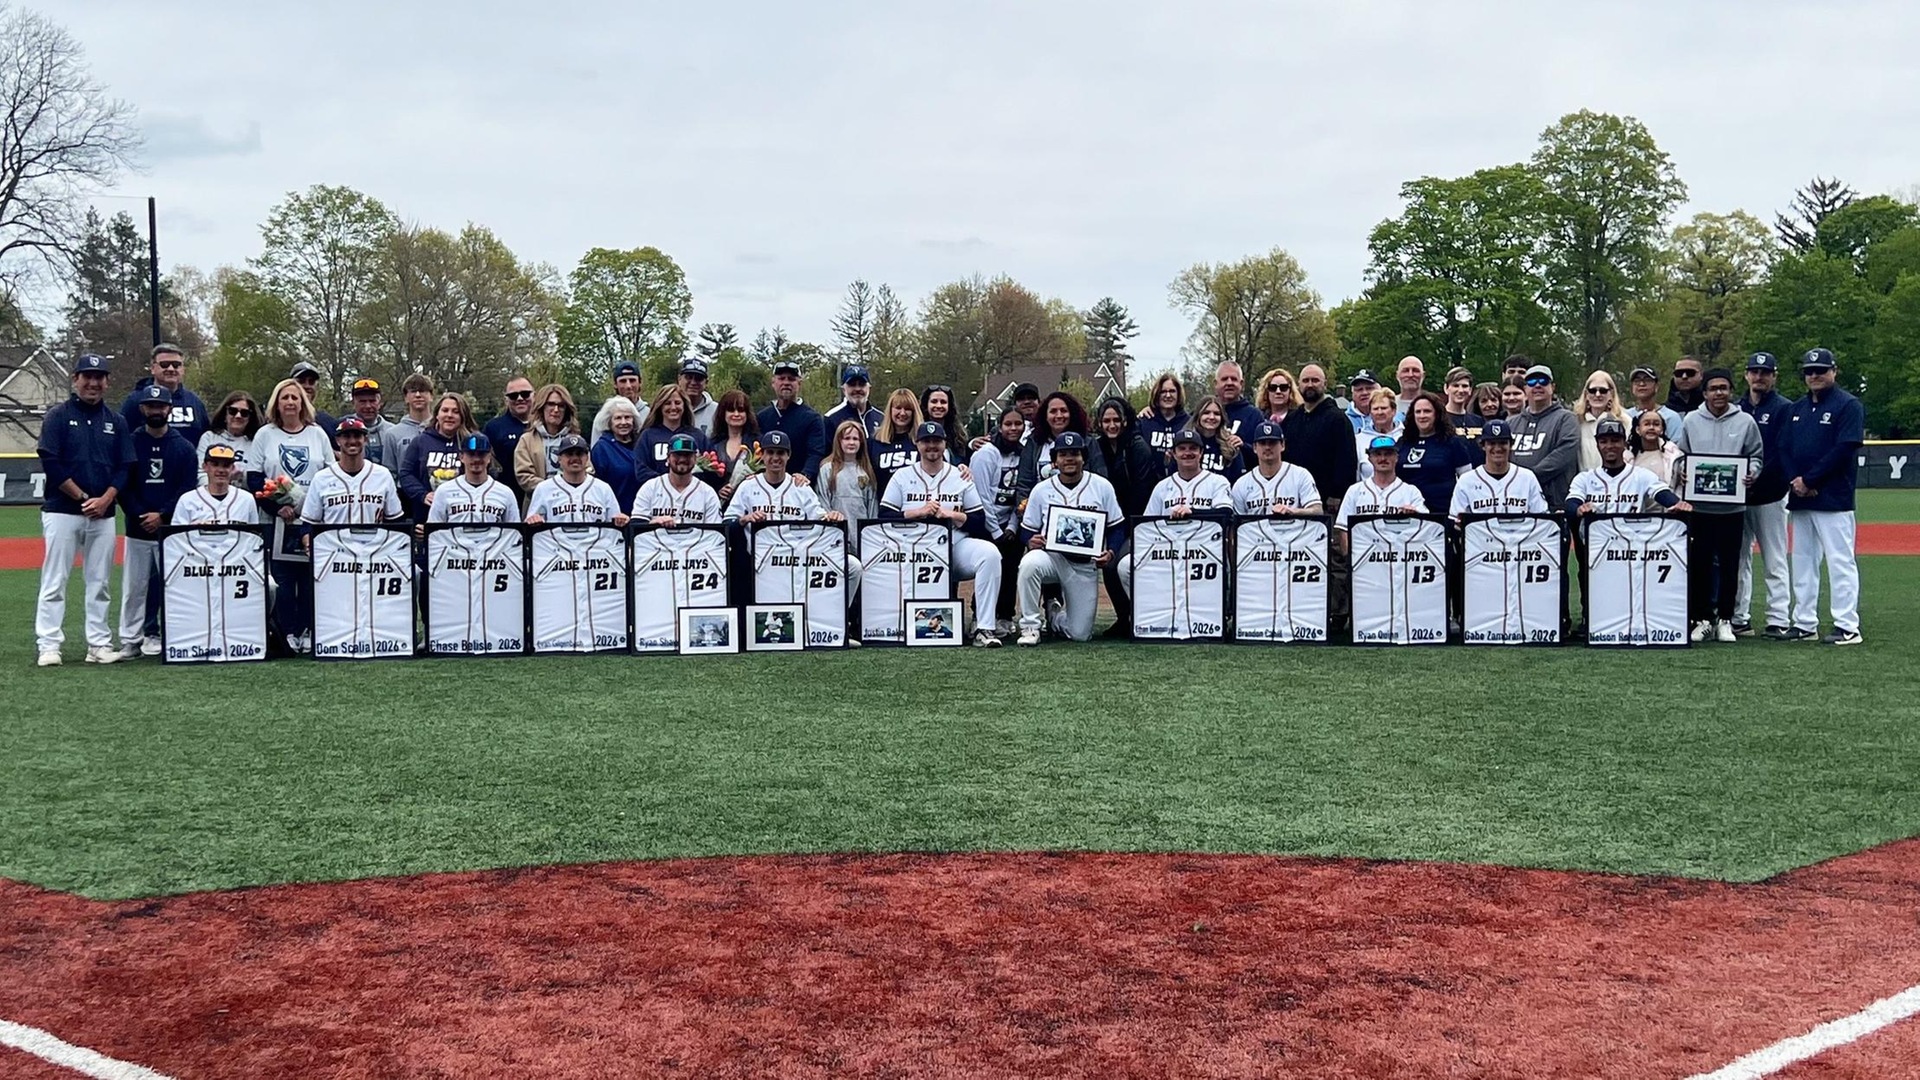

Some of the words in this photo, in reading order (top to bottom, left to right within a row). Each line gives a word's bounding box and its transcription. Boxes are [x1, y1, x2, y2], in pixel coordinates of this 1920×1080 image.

[167, 407, 194, 422] SJ
[1151, 431, 1175, 448] US
[880, 451, 918, 468] USJ
[1888, 456, 1908, 479] Y
[328, 494, 354, 507] BLUE
[358, 494, 383, 504] JAYS
[907, 494, 932, 502] BLUE
[935, 494, 959, 502] JAYS
[1165, 498, 1186, 509] BLUE
[1190, 498, 1212, 506] JAYS
[1247, 499, 1269, 509] BLUE
[1272, 497, 1295, 505] JAYS
[1473, 498, 1499, 509] BLUE
[1502, 498, 1527, 506] JAYS
[1586, 495, 1611, 503] BLUE
[1615, 494, 1639, 502] JAYS
[451, 504, 476, 514] BLUE
[479, 504, 504, 516] JAYS
[552, 504, 576, 516] BLUE
[580, 504, 603, 515] JAYS
[652, 508, 677, 517] BLUE
[679, 509, 703, 521] JAYS
[778, 506, 801, 516] JAYS
[1356, 505, 1380, 514] BLUE
[910, 553, 934, 562] JAYS
[1152, 550, 1179, 560] BLUE
[1182, 550, 1207, 560] JAYS
[1254, 551, 1282, 562] BLUE
[1285, 551, 1310, 561] JAYS
[1369, 552, 1398, 562] BLUE
[1401, 551, 1428, 562] JAYS
[1482, 552, 1511, 562] BLUE
[1514, 550, 1542, 562] JAYS
[1607, 550, 1637, 560] BLUE
[1641, 550, 1670, 560] JAYS
[332, 562, 362, 573] BLUE
[366, 562, 394, 573] JAYS
[447, 559, 477, 570] BLUE
[480, 560, 506, 570] JAYS
[583, 558, 610, 570] JAYS
[651, 560, 679, 571] BLUE
[682, 559, 708, 570] JAYS
[771, 556, 799, 566] BLUE
[803, 556, 827, 567] JAYS
[183, 566, 214, 577] BLUE
[218, 565, 246, 576] JAYS
[917, 567, 944, 583] 27
[1190, 563, 1217, 580] 30
[1292, 566, 1321, 582] 22
[1412, 566, 1436, 583] 13
[1525, 565, 1550, 583] 19
[1658, 565, 1672, 583] 7
[494, 574, 508, 592] 5
[595, 572, 618, 591] 21
[691, 573, 718, 590] 24
[810, 571, 837, 588] 26
[234, 581, 249, 599] 3
[377, 578, 402, 595] 18
[864, 628, 885, 637] Justin
[1193, 622, 1214, 634] 2026
[1294, 626, 1316, 638] 2026
[1412, 628, 1434, 640] 2026
[596, 635, 618, 646] 2026
[811, 631, 833, 643] 2026
[1464, 631, 1484, 640] Gabe
[1652, 630, 1675, 641] 2026
[317, 642, 338, 655] Dom
[341, 642, 370, 654] Scalia
[376, 641, 399, 652] 2026
[430, 640, 458, 651] Chase
[499, 638, 521, 650] 2026
[169, 646, 189, 658] Dan
[230, 644, 254, 657] 2026
